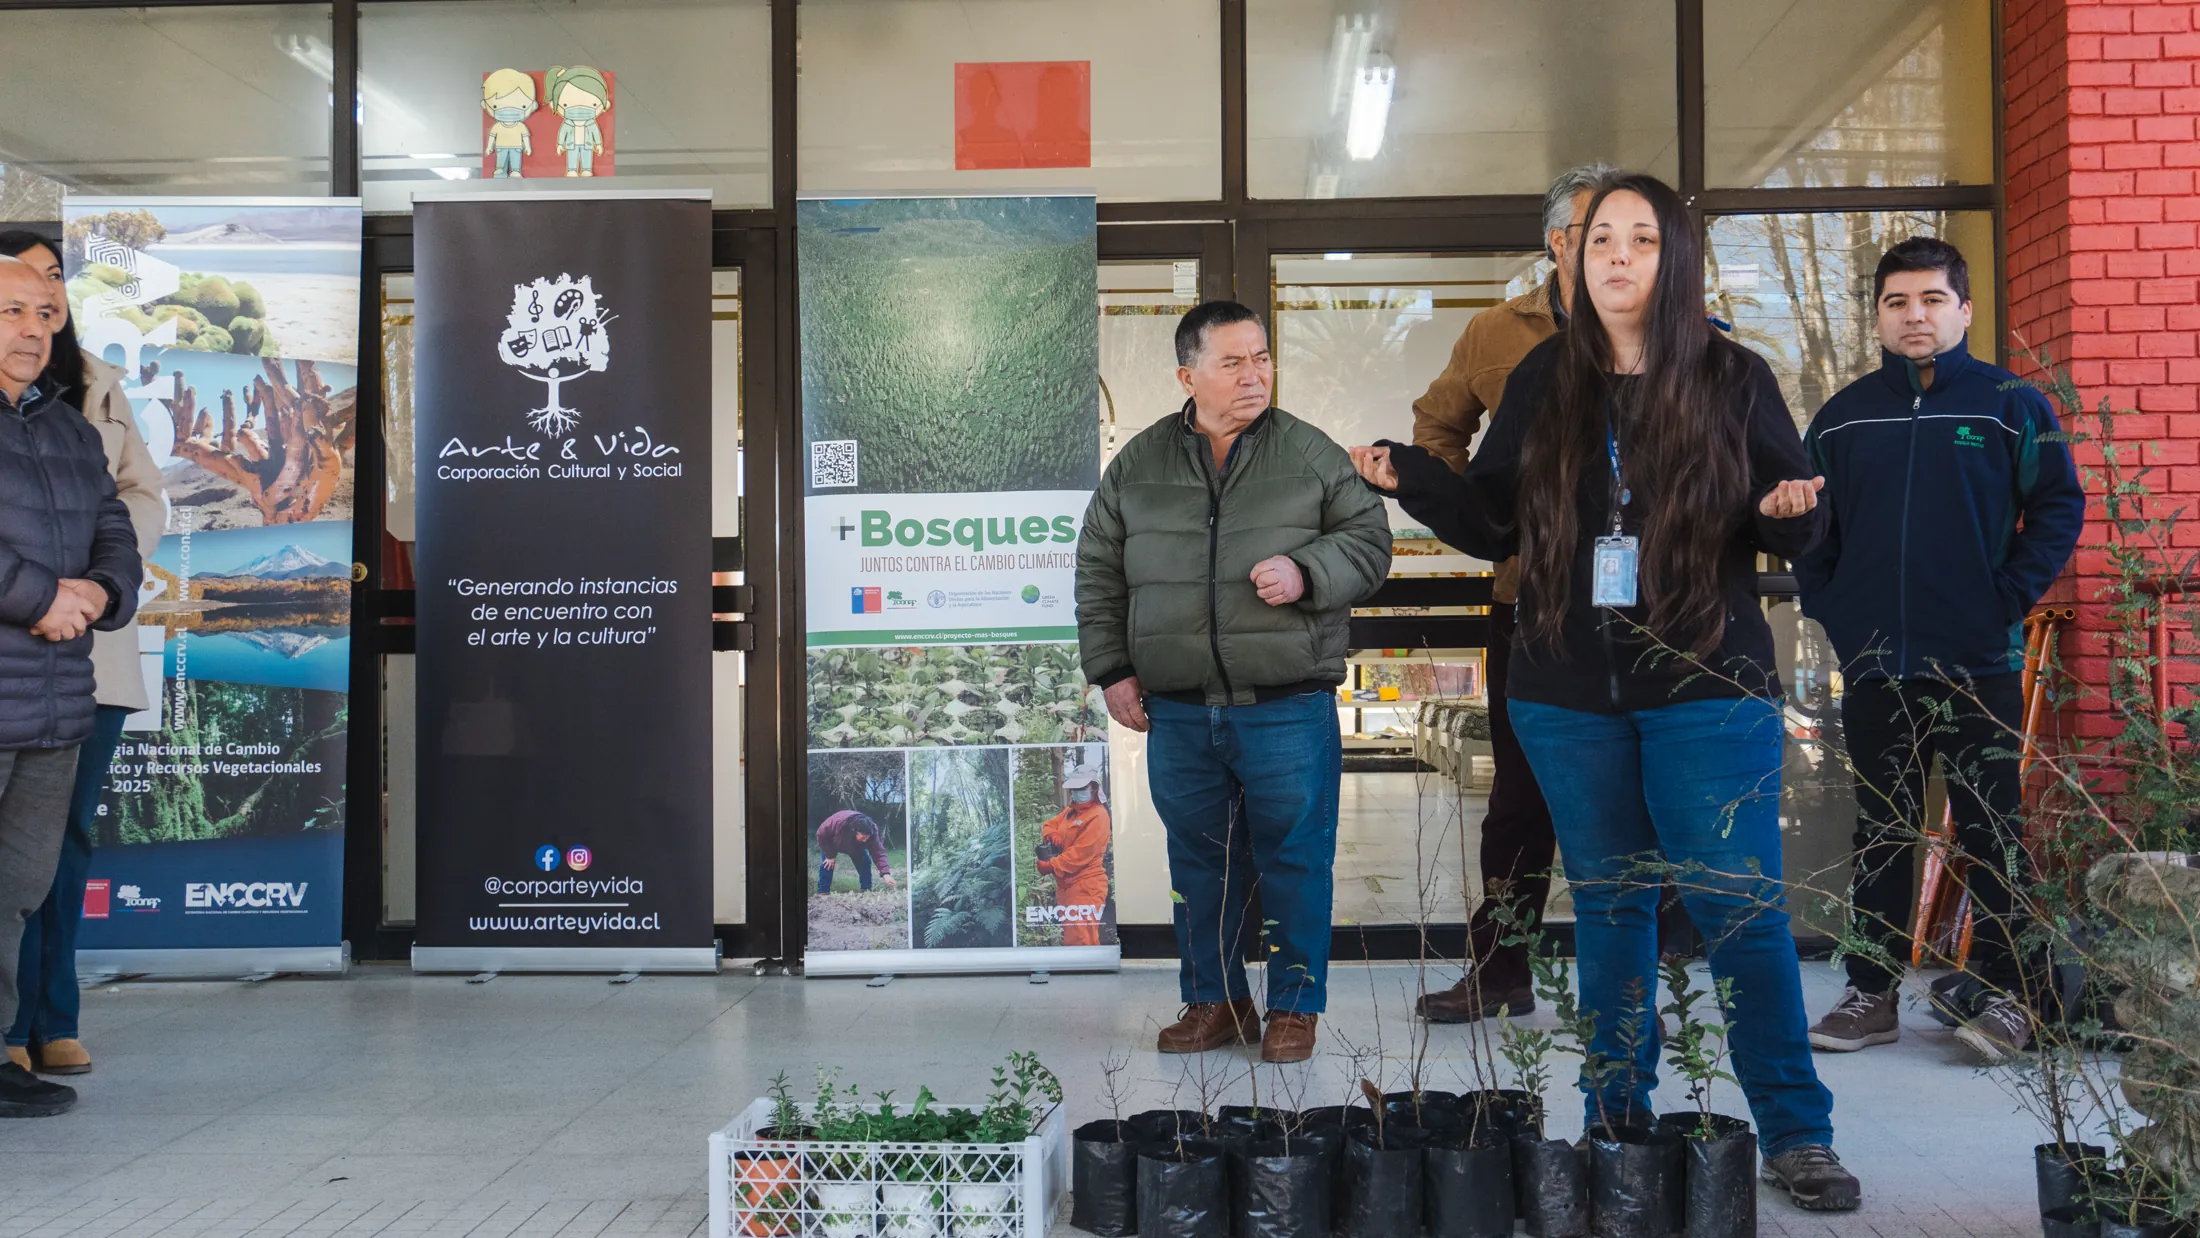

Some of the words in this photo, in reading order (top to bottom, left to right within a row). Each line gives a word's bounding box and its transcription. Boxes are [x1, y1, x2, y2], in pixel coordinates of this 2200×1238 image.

[439, 435, 541, 460] Arte
[560, 438, 578, 460] &
[593, 426, 680, 458] Vida
[437, 464, 540, 482] Corporación
[548, 463, 611, 478] Cultural
[617, 466, 627, 481] y
[633, 462, 682, 478] Social
[179, 506, 192, 602] www.conaf.cl
[860, 556, 903, 573] JUNTOS
[906, 555, 952, 572] CONTRA
[955, 555, 967, 571] EL
[970, 553, 1015, 571] CAMBIO
[448, 577, 574, 596] “Generando
[579, 576, 678, 595] instancias
[471, 603, 498, 621] de
[504, 602, 608, 620] encuentro
[613, 605, 652, 620] con
[467, 628, 486, 646] el
[490, 629, 531, 646] arte
[537, 632, 548, 649] y
[553, 628, 571, 645] la
[577, 626, 656, 645] cultura”
[894, 631, 1018, 640] www.enccrv.cl/proyecto-mas-bosques
[174, 626, 189, 731] www.enccrv.cl
[138, 743, 202, 756] Nacional
[204, 743, 223, 756] de
[225, 742, 280, 756] Cambio
[134, 763, 143, 777] y
[147, 761, 210, 775] Recursos
[212, 760, 322, 776] Vegetacionales
[112, 779, 151, 793] 2025
[185, 882, 309, 907] ENCCRV
[484, 876, 643, 898] @corparteyvida
[469, 912, 661, 934] www.arteyvida.cl
[1026, 904, 1106, 922] ENCCRV
